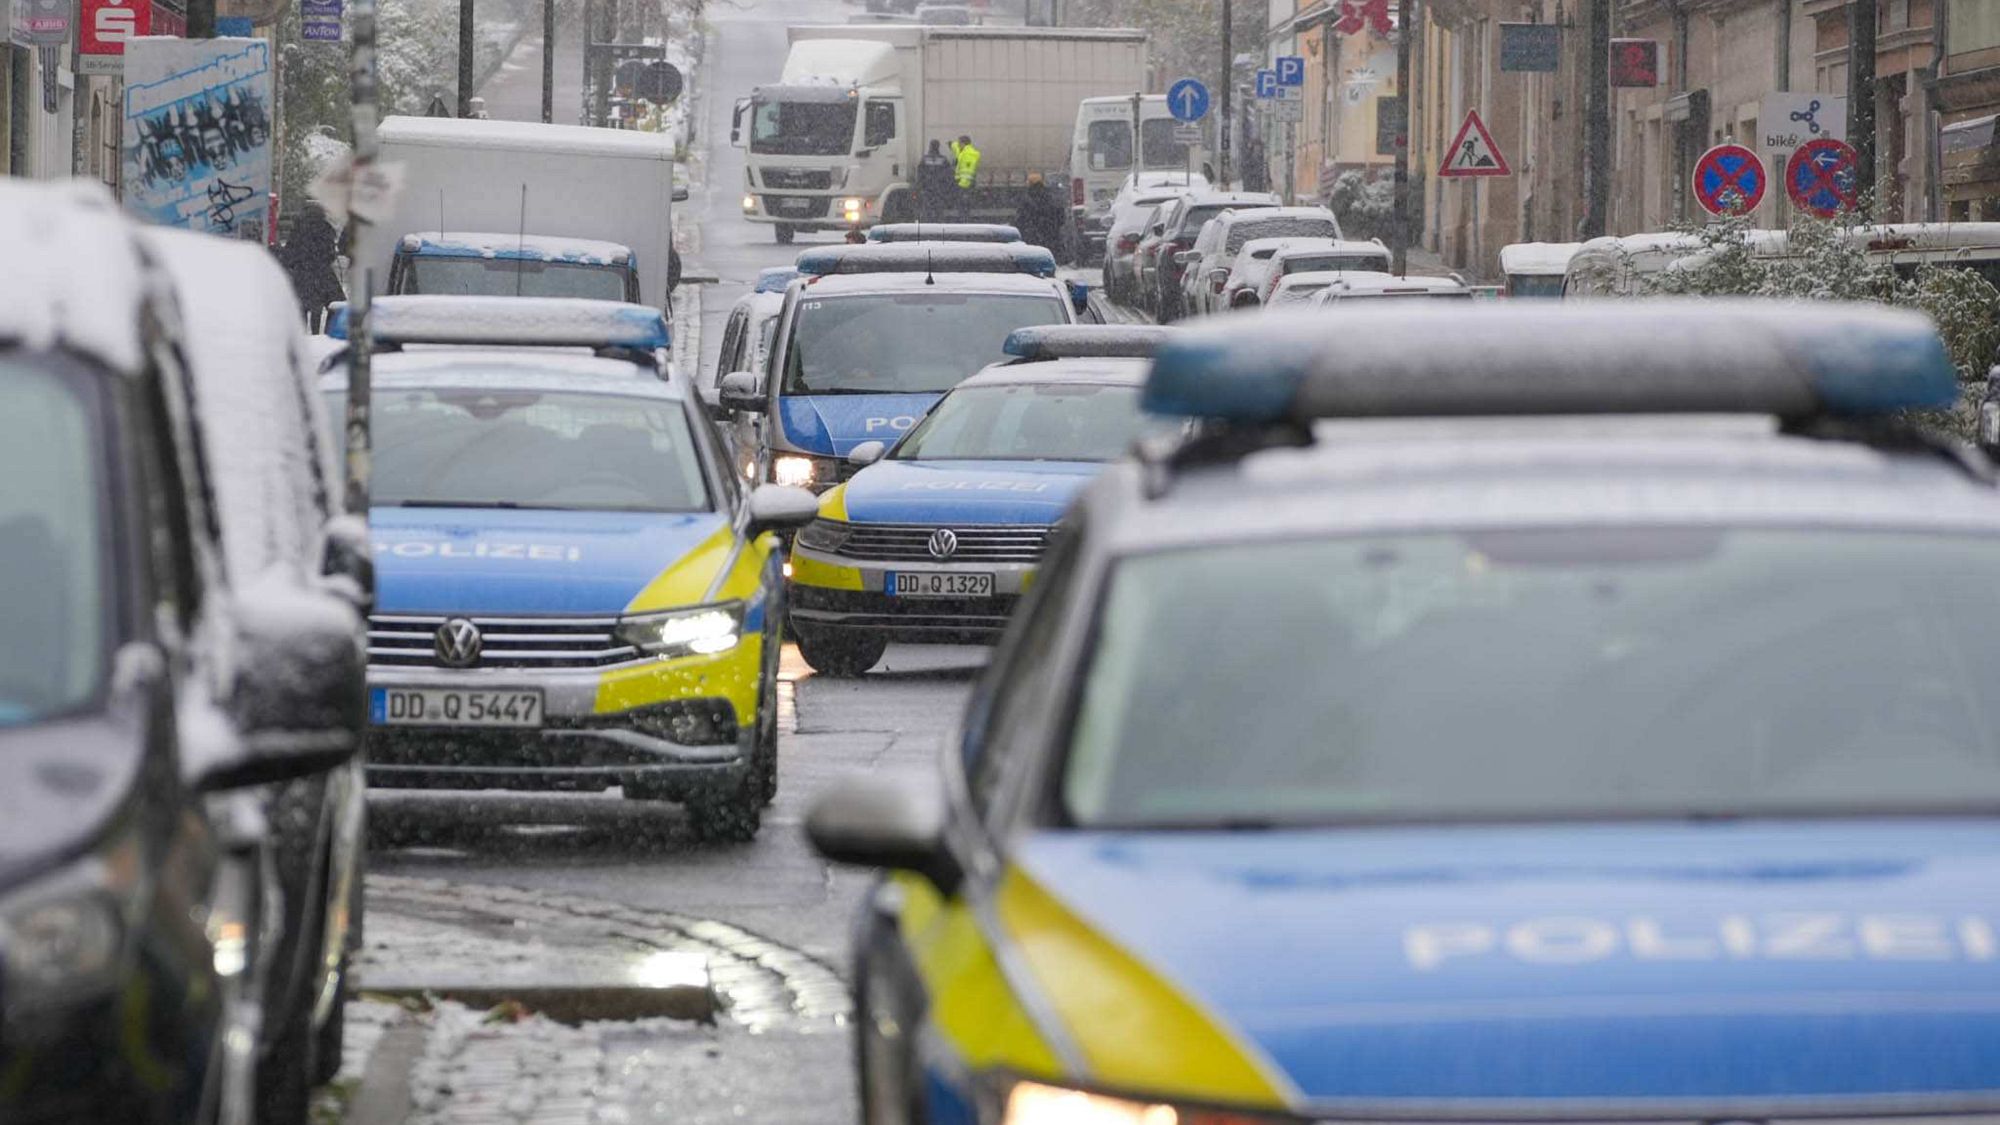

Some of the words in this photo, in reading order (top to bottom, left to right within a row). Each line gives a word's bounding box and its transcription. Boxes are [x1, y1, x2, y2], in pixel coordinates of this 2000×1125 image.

[34, 20, 63, 29] ABUS
[304, 25, 339, 37] ANTON
[1767, 134, 1797, 147] bike
[904, 480, 1048, 493] POLIZEI
[897, 575, 919, 593] DD
[930, 575, 943, 593] Q
[946, 576, 990, 594] 1329
[390, 693, 424, 719] DD
[443, 694, 462, 720] Q
[468, 694, 537, 721] 5447
[1404, 915, 1997, 971] POLIZEI
